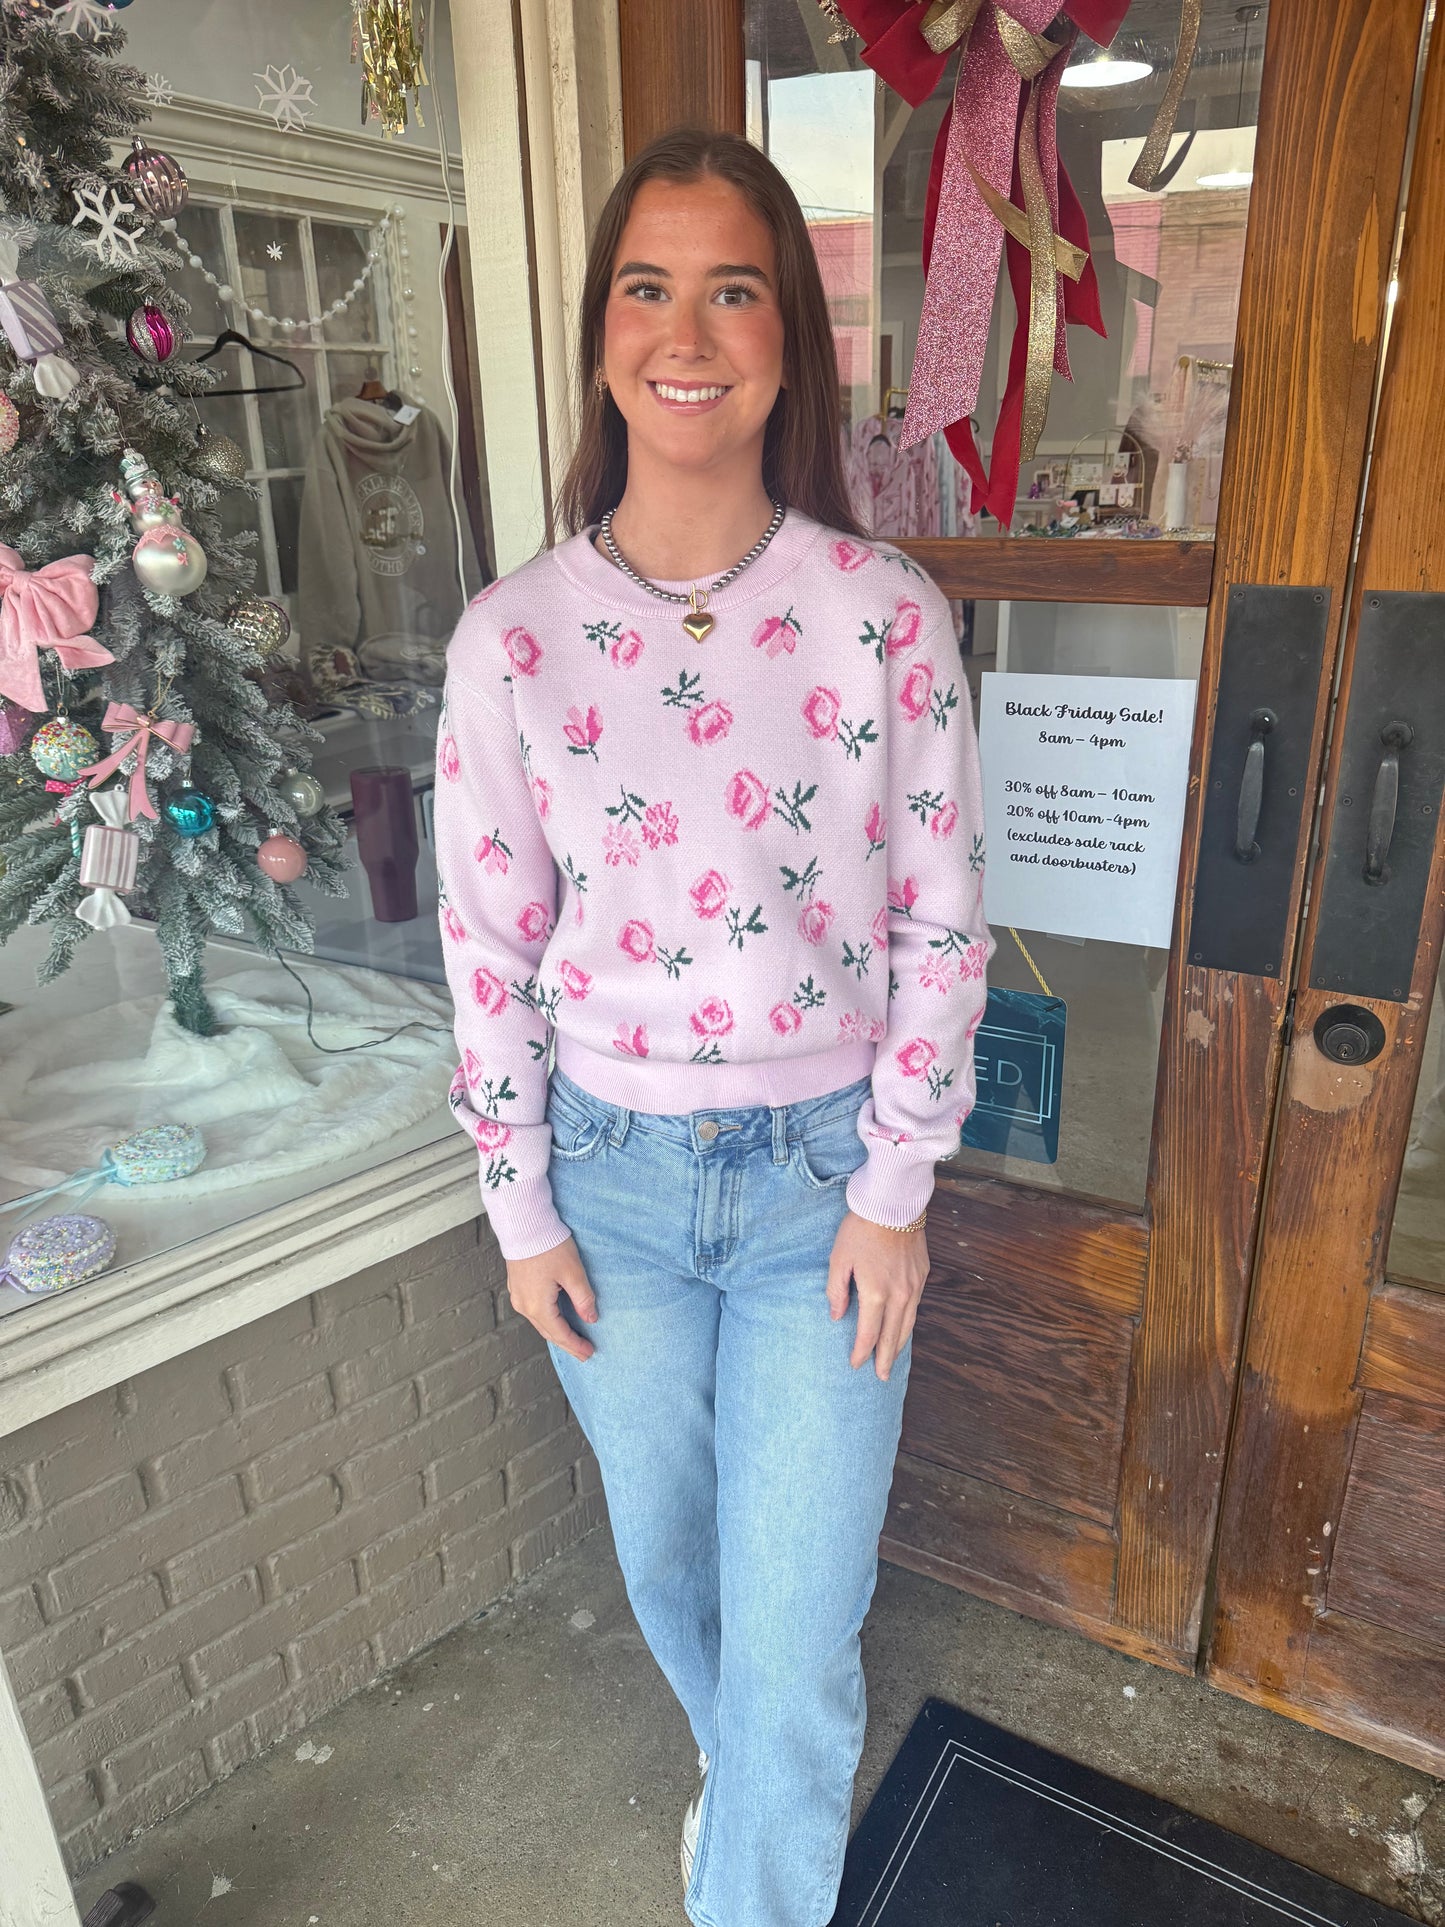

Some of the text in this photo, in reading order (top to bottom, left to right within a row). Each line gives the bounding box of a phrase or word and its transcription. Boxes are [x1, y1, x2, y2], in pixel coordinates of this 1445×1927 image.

[1005, 701, 1164, 725] Black Friday Sale!
[1038, 730, 1074, 745] 8am
[1089, 733, 1127, 750] 4pm
[1004, 780, 1032, 794] 30%
[1035, 784, 1059, 800] off
[1060, 784, 1096, 799] 8am
[1111, 788, 1156, 803] 10am
[1006, 804, 1034, 818] 20%
[1037, 809, 1061, 825] off
[1062, 810, 1105, 825] 10am
[1007, 827, 1146, 853] (excludes sale rack
[1009, 852, 1137, 876] and doorbusters)
